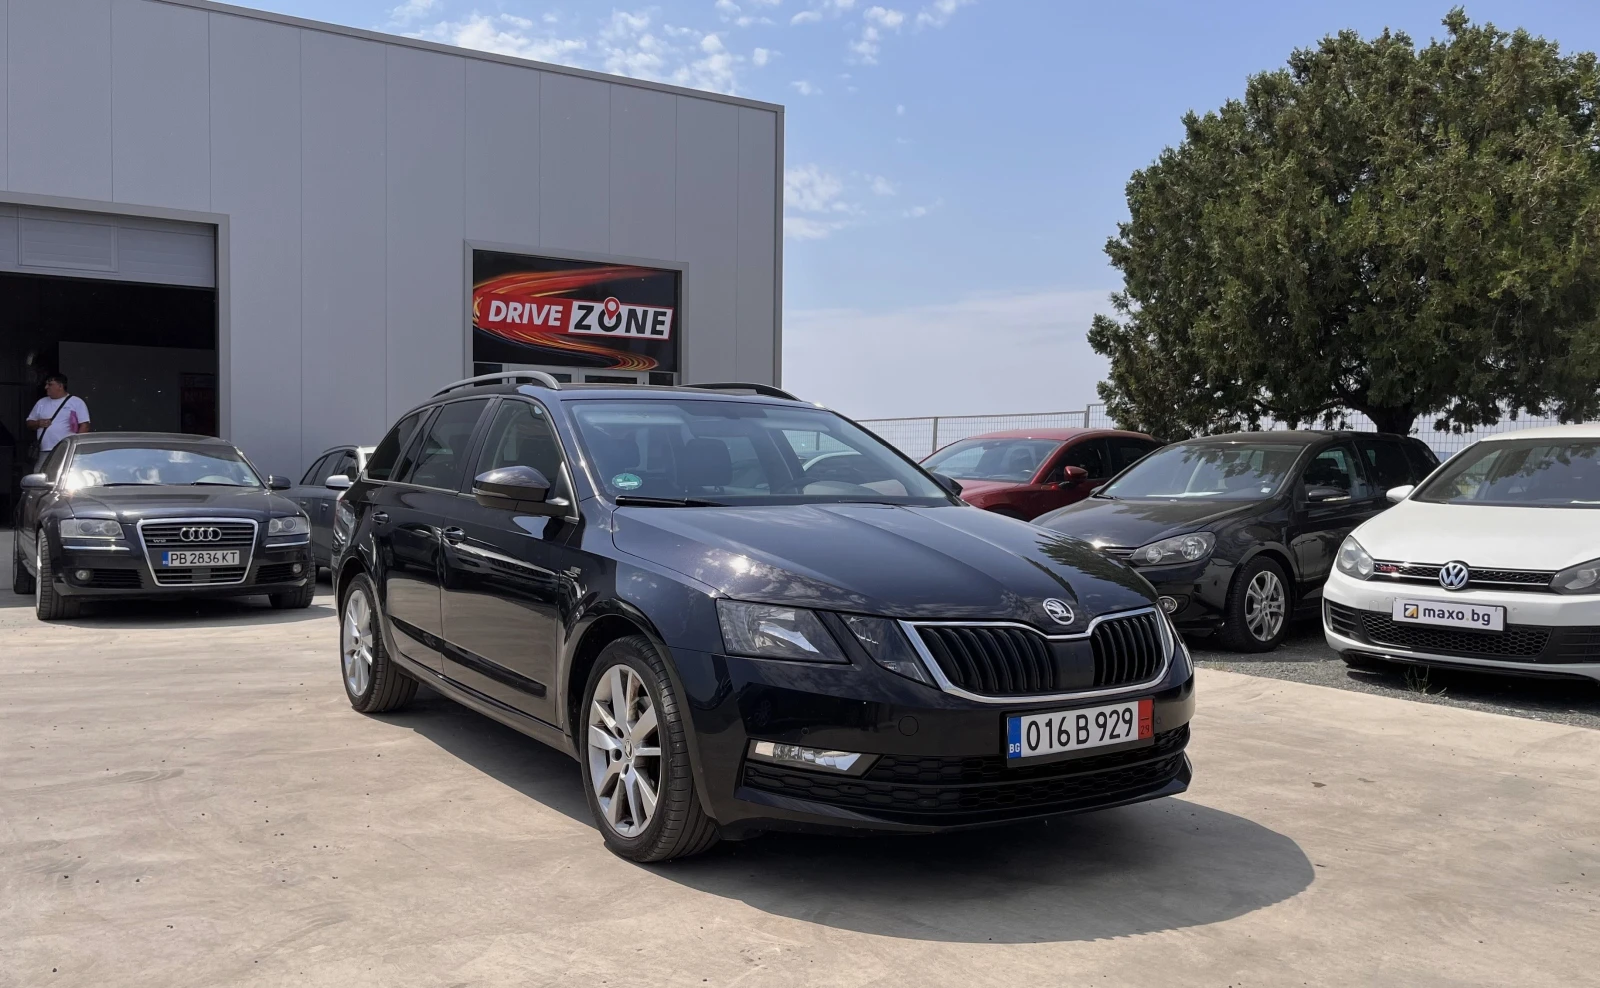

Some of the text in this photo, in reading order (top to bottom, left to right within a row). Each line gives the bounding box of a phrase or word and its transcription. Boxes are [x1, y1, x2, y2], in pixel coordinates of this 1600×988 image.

[488, 300, 668, 336] DRIVE ZONE
[170, 551, 238, 565] PB 2836 KT
[1423, 606, 1491, 626] maxo.bg
[1140, 724, 1150, 735] 29
[1009, 743, 1021, 753] BG
